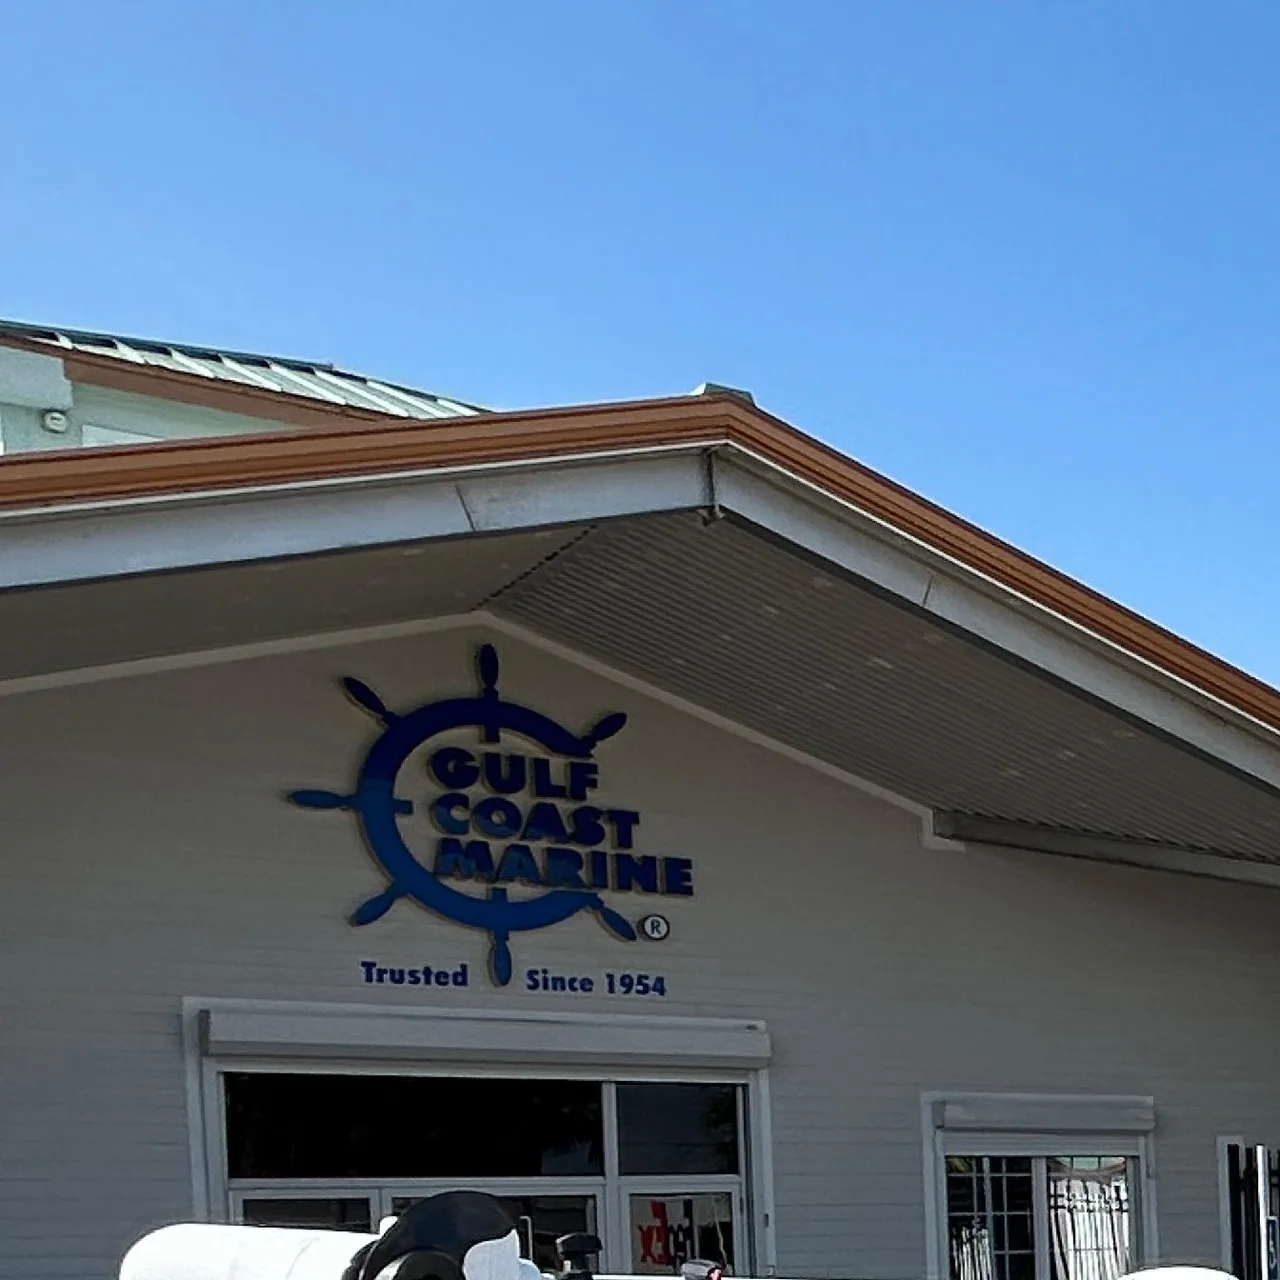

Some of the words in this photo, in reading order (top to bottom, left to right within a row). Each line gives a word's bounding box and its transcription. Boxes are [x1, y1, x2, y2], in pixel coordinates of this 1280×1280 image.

[430, 746, 599, 801] GULF
[430, 792, 640, 849] COAST
[433, 837, 694, 896] MARINE
[360, 960, 469, 987] Trusted
[525, 970, 595, 994] Since
[605, 973, 666, 996] 1954
